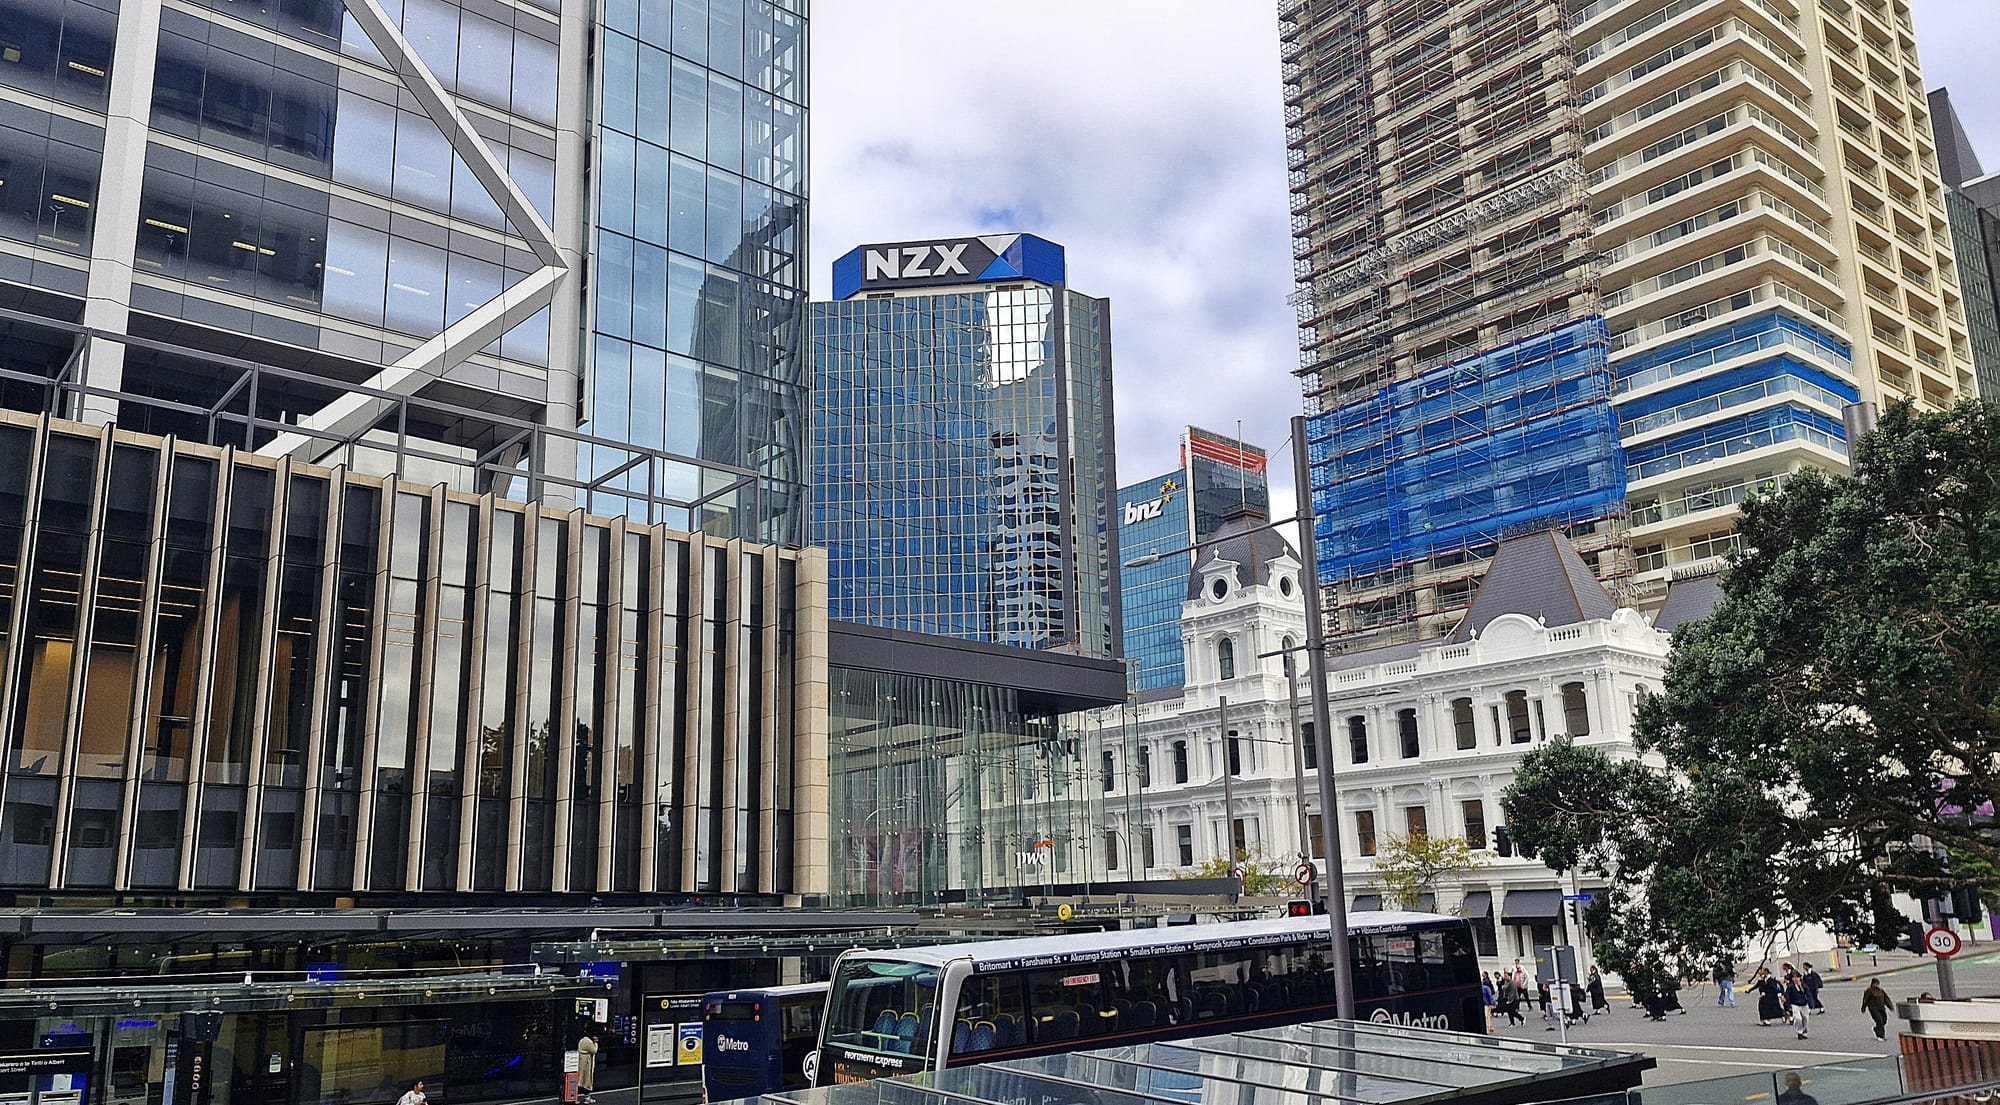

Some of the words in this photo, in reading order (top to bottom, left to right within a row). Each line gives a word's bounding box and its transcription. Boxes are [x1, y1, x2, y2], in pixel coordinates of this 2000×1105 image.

[866, 243, 970, 280] NZX
[1124, 500, 1163, 525] bnz
[1016, 851, 1047, 869] pwc
[1060, 907, 1067, 916] C
[979, 960, 1012, 972] Britomart
[1021, 957, 1053, 968] Fanshawe
[1053, 955, 1061, 964] St
[1070, 952, 1100, 963] Akoranga
[1100, 949, 1122, 959] Station
[1129, 947, 1151, 957] Smales
[1151, 945, 1166, 955] Farm
[1166, 943, 1186, 953] Station
[1193, 940, 1222, 952] Sunnynook
[1223, 938, 1242, 948] Station
[1248, 935, 1280, 945] Constellation
[1281, 933, 1291, 942] Park
[1297, 932, 1308, 941] Ride
[1313, 931, 1330, 940] Albany
[1392, 924, 1407, 932] Station
[1934, 936, 1951, 947] 30
[726, 1038, 749, 1051] Metro
[844, 1050, 874, 1063] Northern
[875, 1055, 903, 1068] Express
